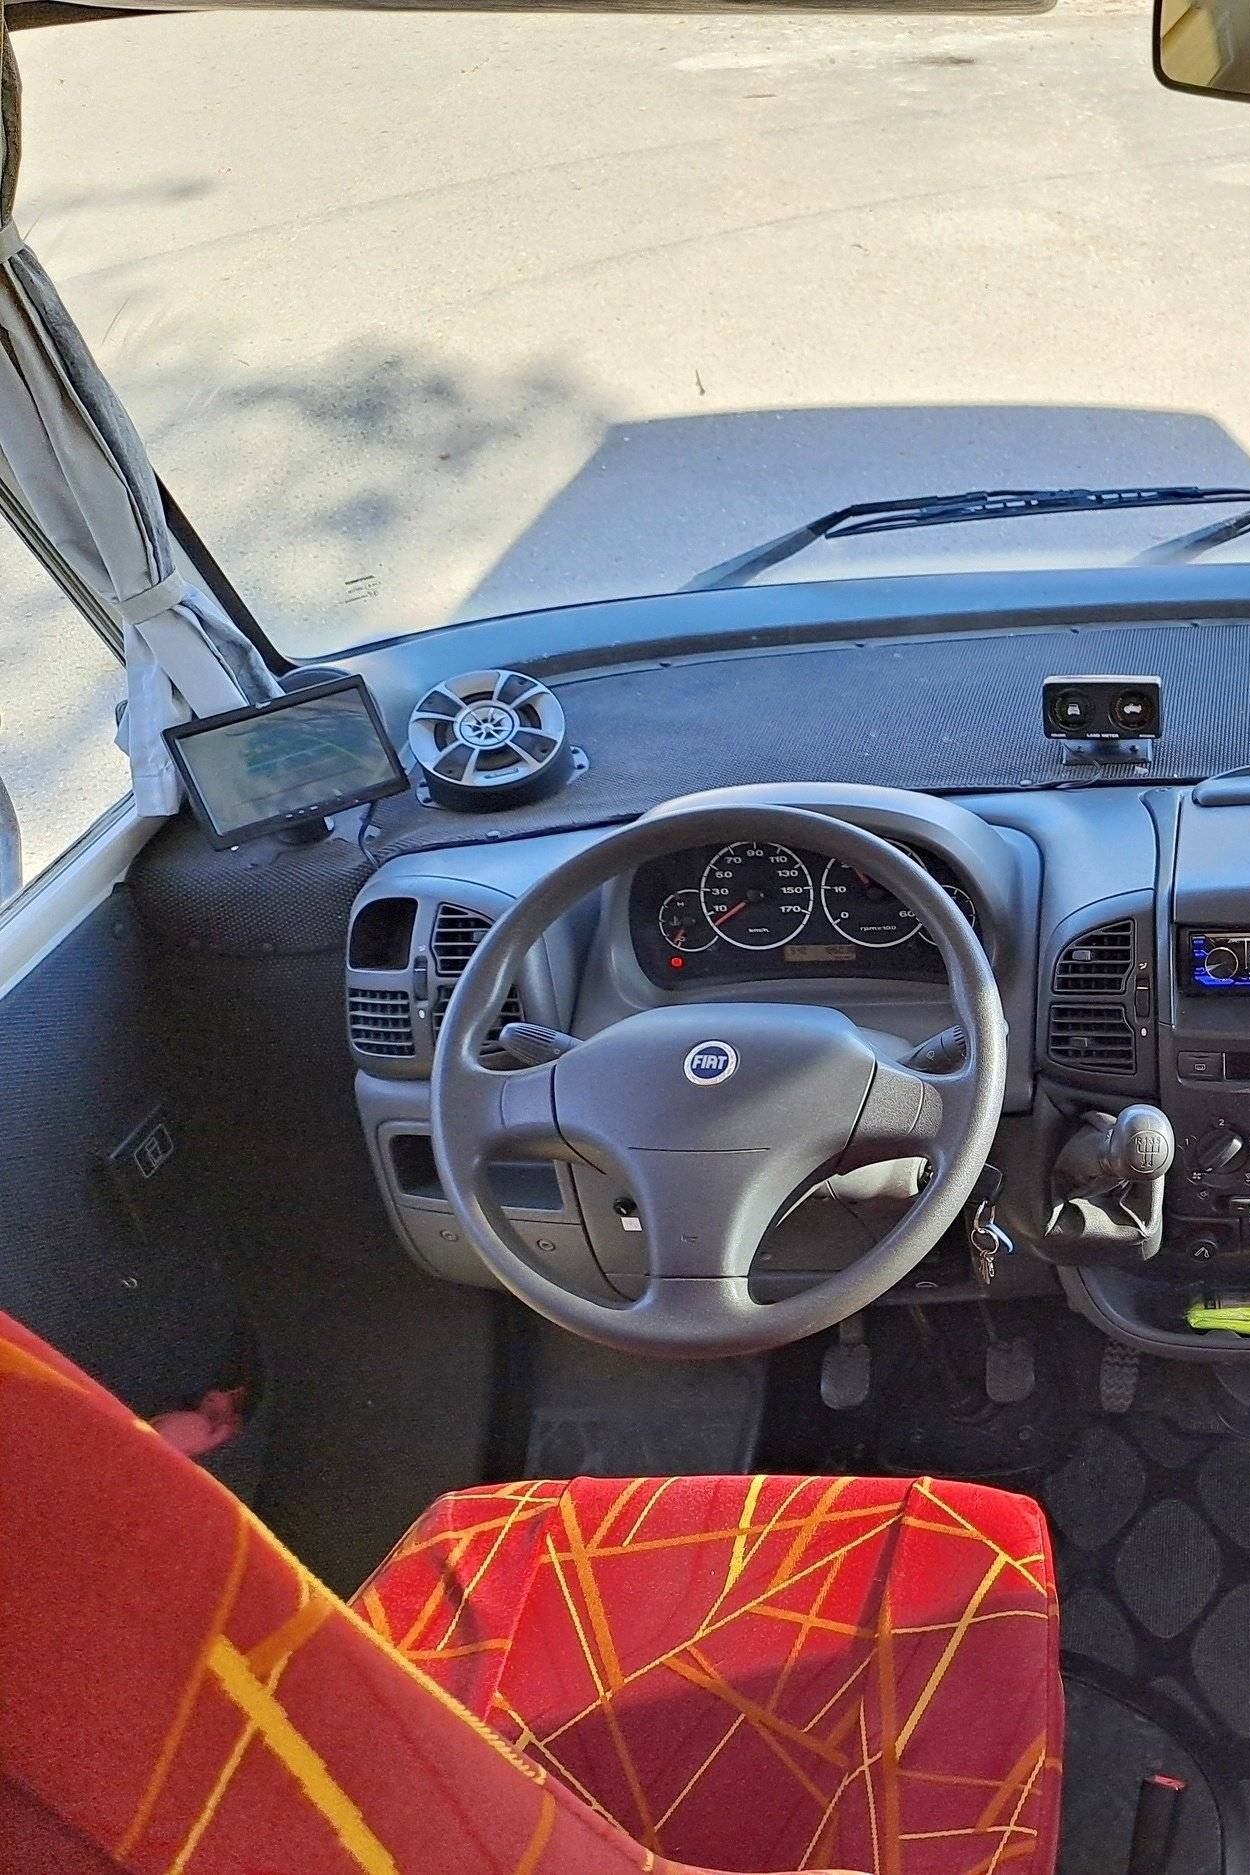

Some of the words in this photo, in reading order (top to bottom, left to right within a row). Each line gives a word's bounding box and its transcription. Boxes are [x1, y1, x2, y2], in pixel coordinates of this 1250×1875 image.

[746, 849, 764, 857] 90
[724, 856, 742, 864] 70
[777, 869, 799, 877] 130
[711, 888, 729, 896] 30
[840, 911, 849, 919] 0
[898, 910, 916, 918] 60
[692, 1054, 728, 1070] FIAT
[1219, 1118, 1225, 1127] 2
